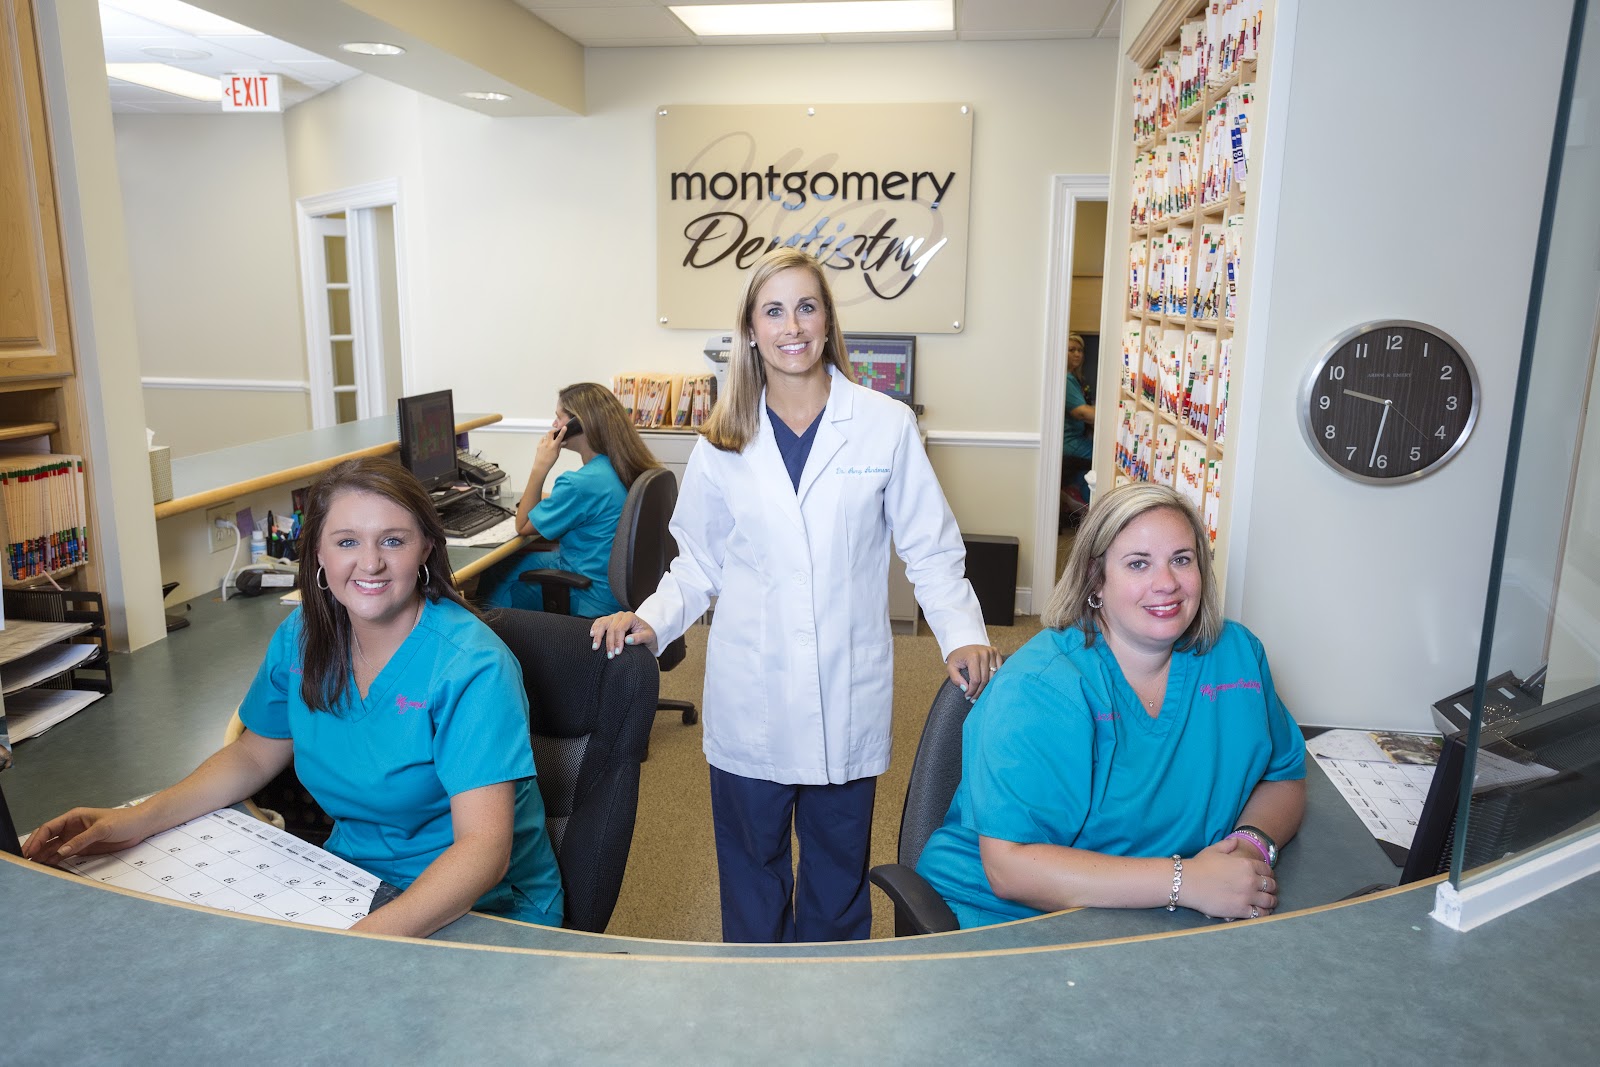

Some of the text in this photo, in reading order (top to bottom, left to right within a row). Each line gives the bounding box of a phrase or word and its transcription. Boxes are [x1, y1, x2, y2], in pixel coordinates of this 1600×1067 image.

[231, 77, 268, 107] EXIT
[670, 165, 956, 211] montgomery
[1385, 335, 1403, 350] 12
[1423, 342, 1429, 357] 1
[1355, 343, 1368, 358] 11
[1329, 365, 1345, 380] 10
[1440, 365, 1453, 380] 2
[1319, 395, 1331, 410] 9
[1445, 396, 1458, 411] 3
[1324, 425, 1336, 439] 8
[1434, 425, 1446, 440] 4
[1345, 446, 1357, 461] 7
[1409, 446, 1421, 461] 5
[1376, 454, 1388, 469] 6
[345, 896, 359, 904] 30
